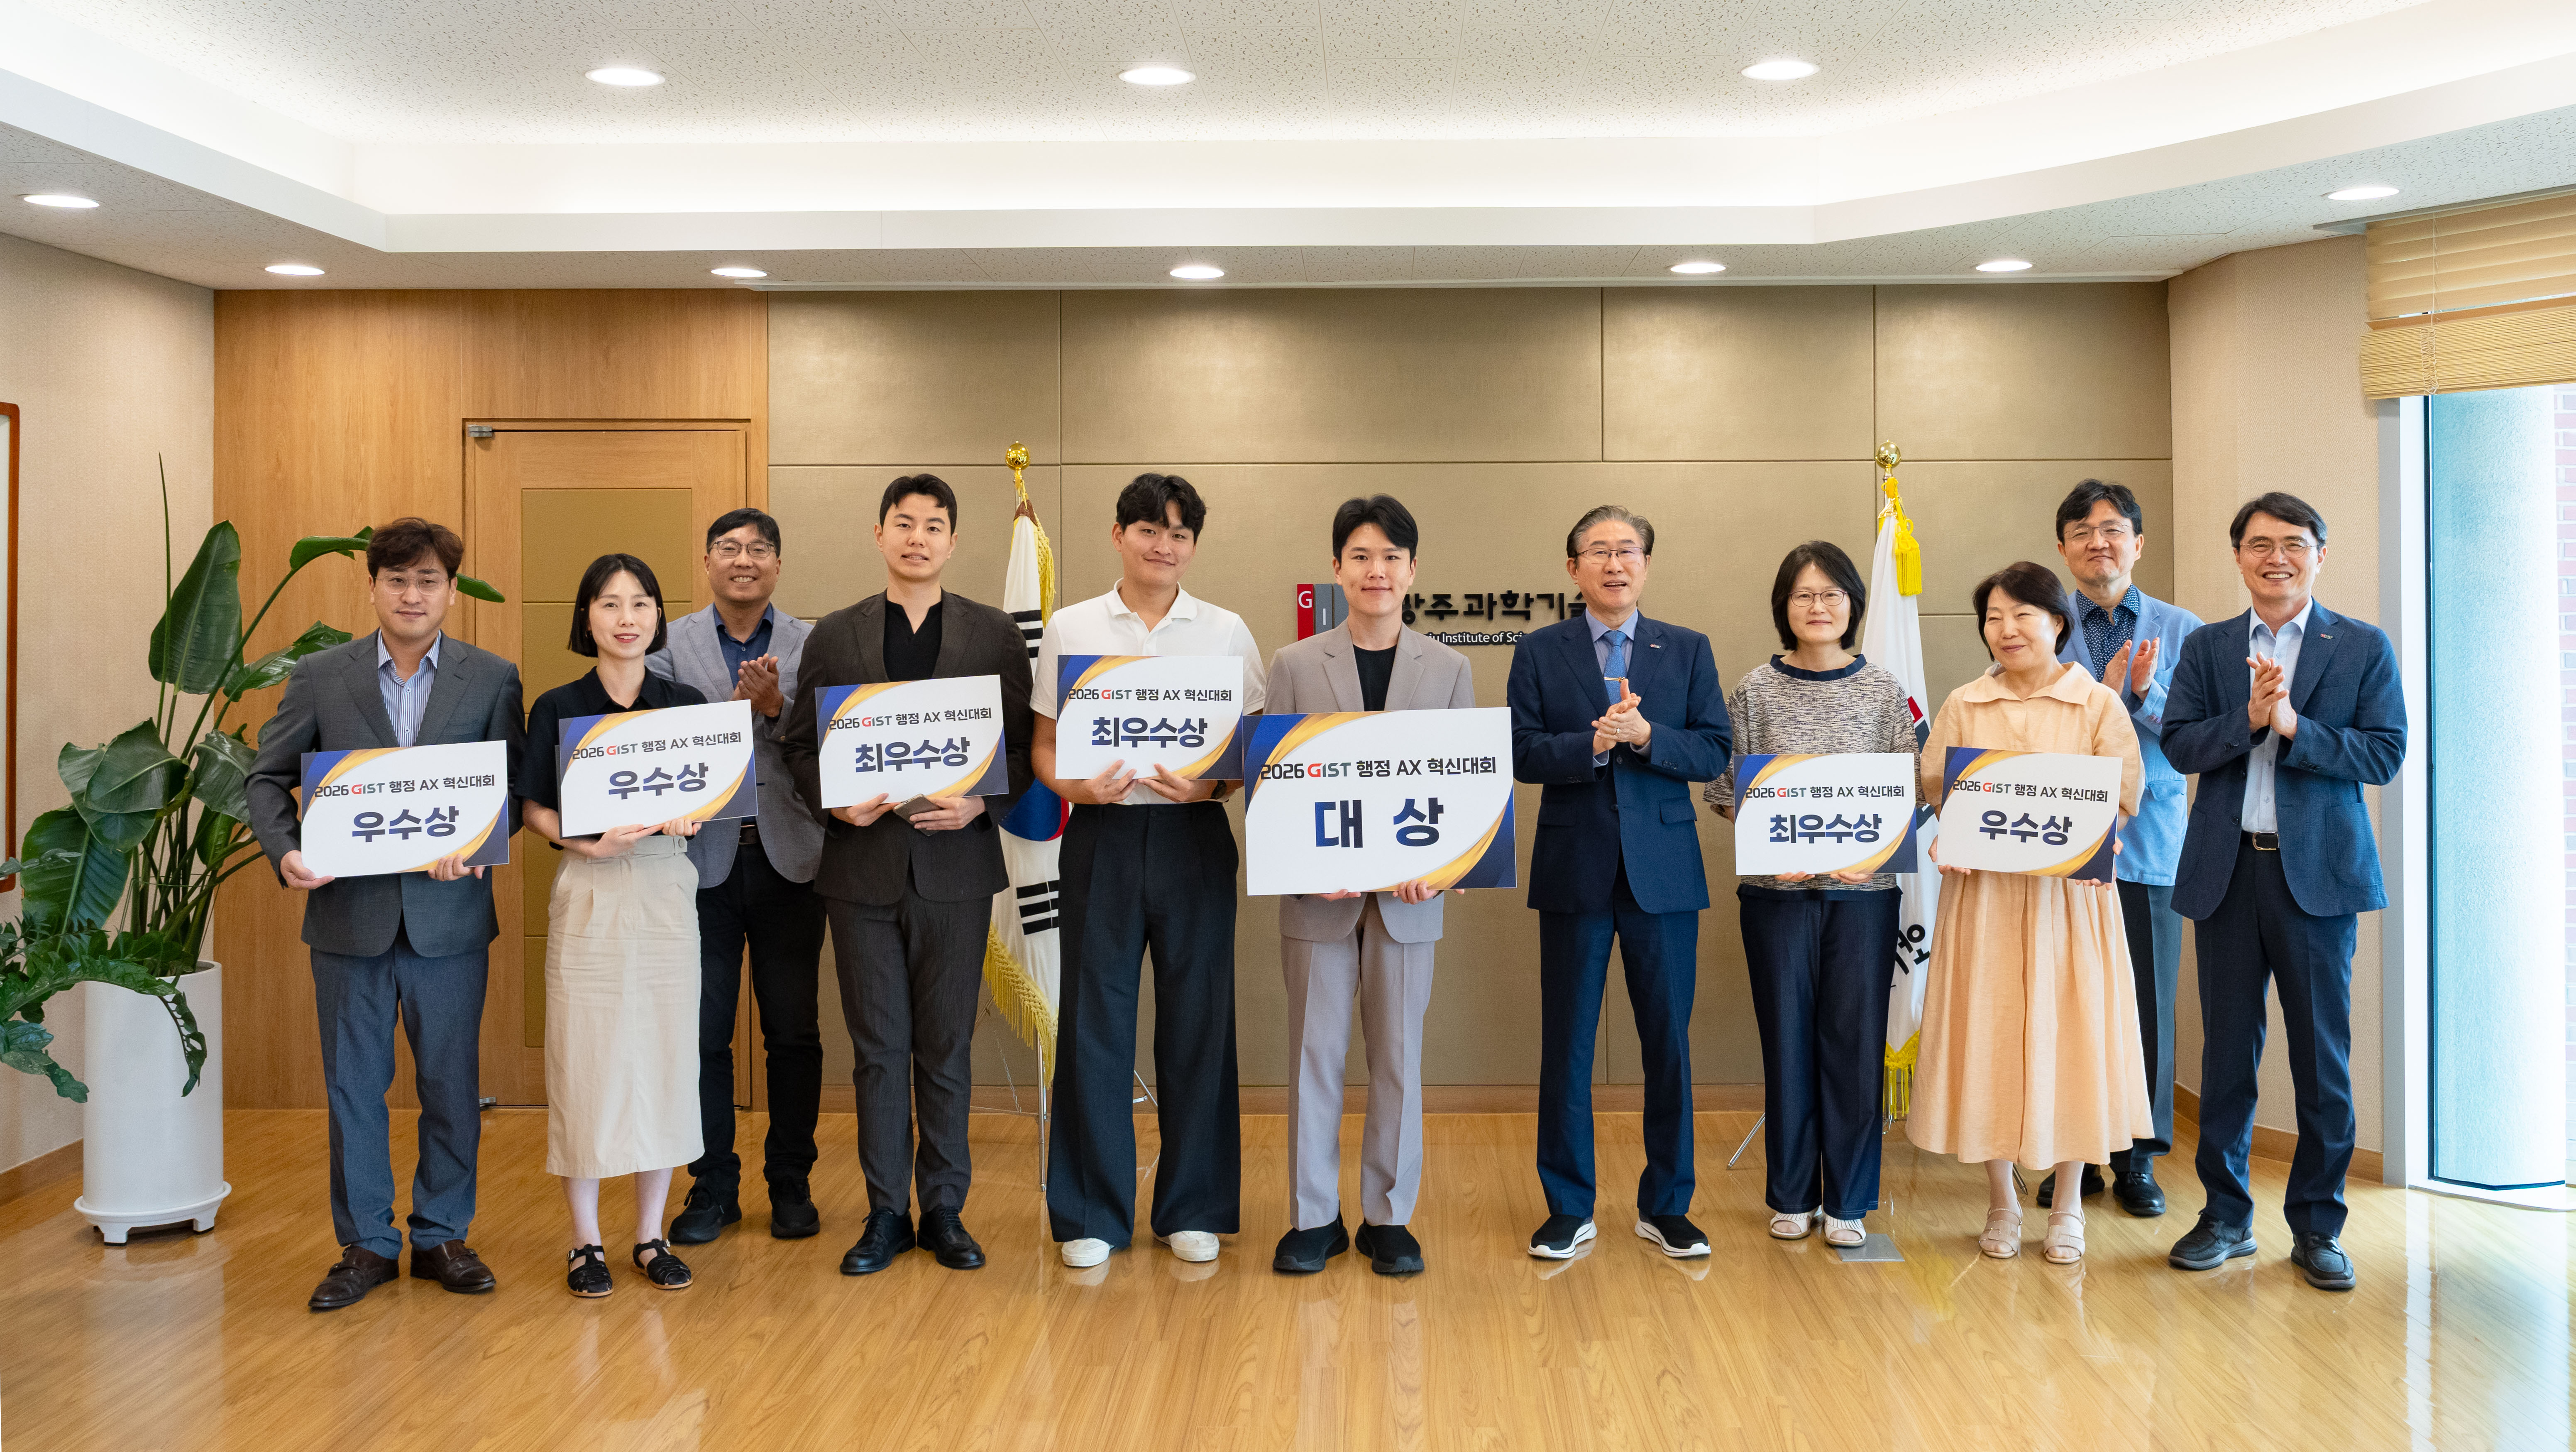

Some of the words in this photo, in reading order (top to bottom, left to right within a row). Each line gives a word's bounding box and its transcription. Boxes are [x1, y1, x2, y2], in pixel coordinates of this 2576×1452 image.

[1442, 633, 1489, 642] Institute
[1492, 632, 1503, 642] of
[1068, 688, 1099, 700] 2026
[1102, 690, 1132, 699] GIST
[1136, 689, 1158, 700] 행정
[1163, 690, 1180, 700] AX
[1185, 689, 1231, 701] 혁신대회
[829, 717, 860, 730] 2026
[862, 716, 892, 727] GIST
[896, 713, 919, 725] 행정
[924, 712, 941, 722] AX
[944, 708, 991, 721] 혁신대회
[1092, 717, 1207, 748] 최우수상
[572, 747, 604, 759] 2026
[607, 744, 638, 755] GIST
[642, 740, 665, 752] 행정
[671, 738, 688, 749] AX
[692, 732, 741, 746] 혁신대회
[855, 737, 970, 772] 최우수상
[1261, 763, 1304, 779] 2026
[1308, 763, 1351, 777] GIST
[1356, 760, 1390, 777] 행정
[1396, 760, 1422, 775] AX
[1427, 757, 1496, 775] 혁신대회
[314, 784, 349, 797] 2026
[352, 783, 385, 794] GIST
[389, 780, 415, 793] 행정
[420, 779, 438, 790] AX
[443, 775, 494, 788] 혁신대회
[609, 763, 708, 799] 우수상
[1745, 787, 1774, 798] 2026
[1777, 788, 1806, 797] GIST
[1810, 787, 1833, 798] 행정
[1837, 787, 1854, 797] AX
[1858, 786, 1904, 797] 혁신대회
[1953, 780, 1980, 792] 2026
[1983, 783, 2011, 793] GIST
[2015, 784, 2036, 796] 행정
[2040, 787, 2058, 798] AX
[2062, 788, 2107, 802] 혁신대회
[352, 806, 459, 842] 우수상
[1770, 814, 1882, 844] 최우수상
[1980, 810, 2072, 845] 우수상
